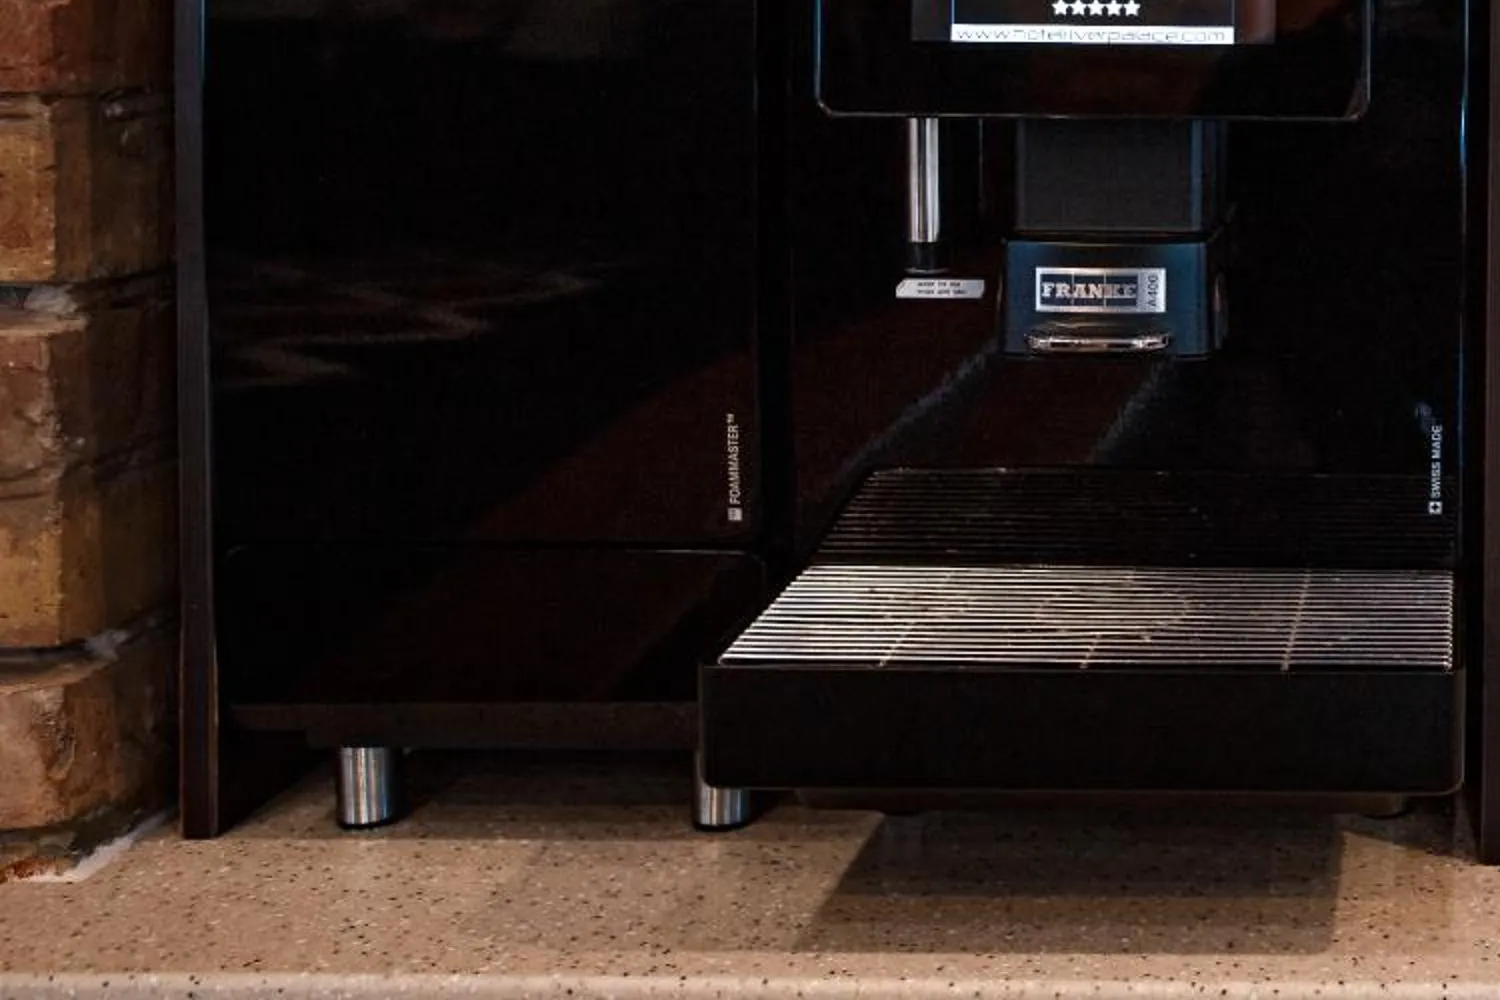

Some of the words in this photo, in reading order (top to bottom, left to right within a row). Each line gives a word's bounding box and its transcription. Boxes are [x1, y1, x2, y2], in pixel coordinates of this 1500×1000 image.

[1040, 281, 1138, 299] FRANKE
[1430, 424, 1442, 459] MADE
[1430, 461, 1441, 499] SWISS
